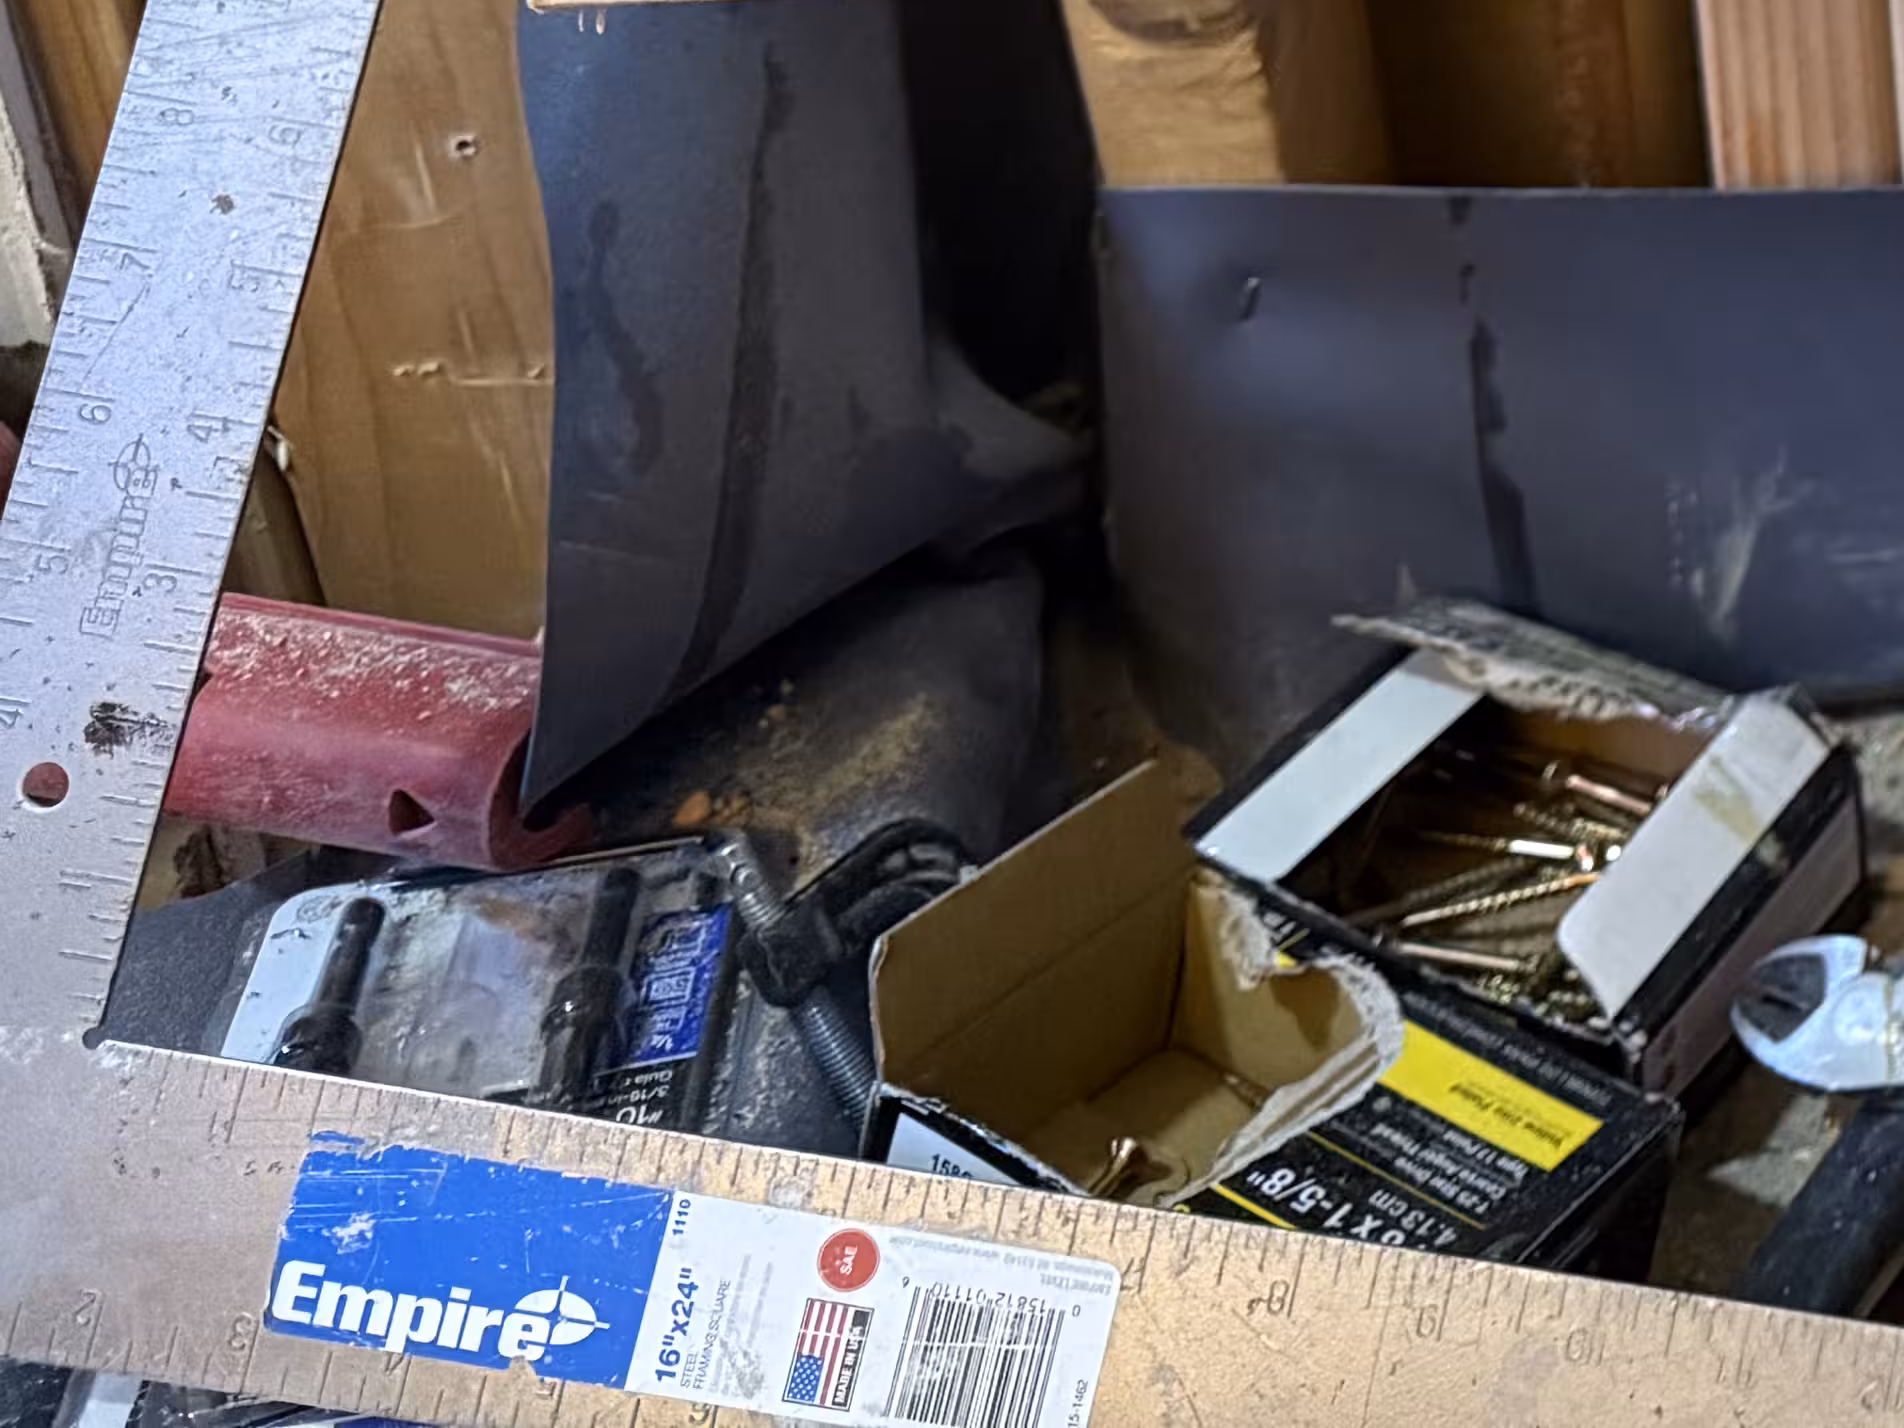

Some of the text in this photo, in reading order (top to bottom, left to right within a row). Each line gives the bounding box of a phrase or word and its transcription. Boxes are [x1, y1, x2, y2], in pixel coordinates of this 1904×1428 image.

[75, 398, 114, 429] 6
[79, 465, 161, 639] Empire
[139, 566, 180, 597] 3
[672, 1198, 692, 1236] 1110
[1246, 1167, 1350, 1227] 1-5/8"
[1368, 1187, 1459, 1247] 4.13 cm
[839, 1244, 859, 1277] SAE
[270, 1258, 552, 1363] Empire
[901, 1275, 1081, 1318] 0 15812 01110 6
[654, 1266, 700, 1383] 16"x24"
[834, 1364, 854, 1404] MADE
